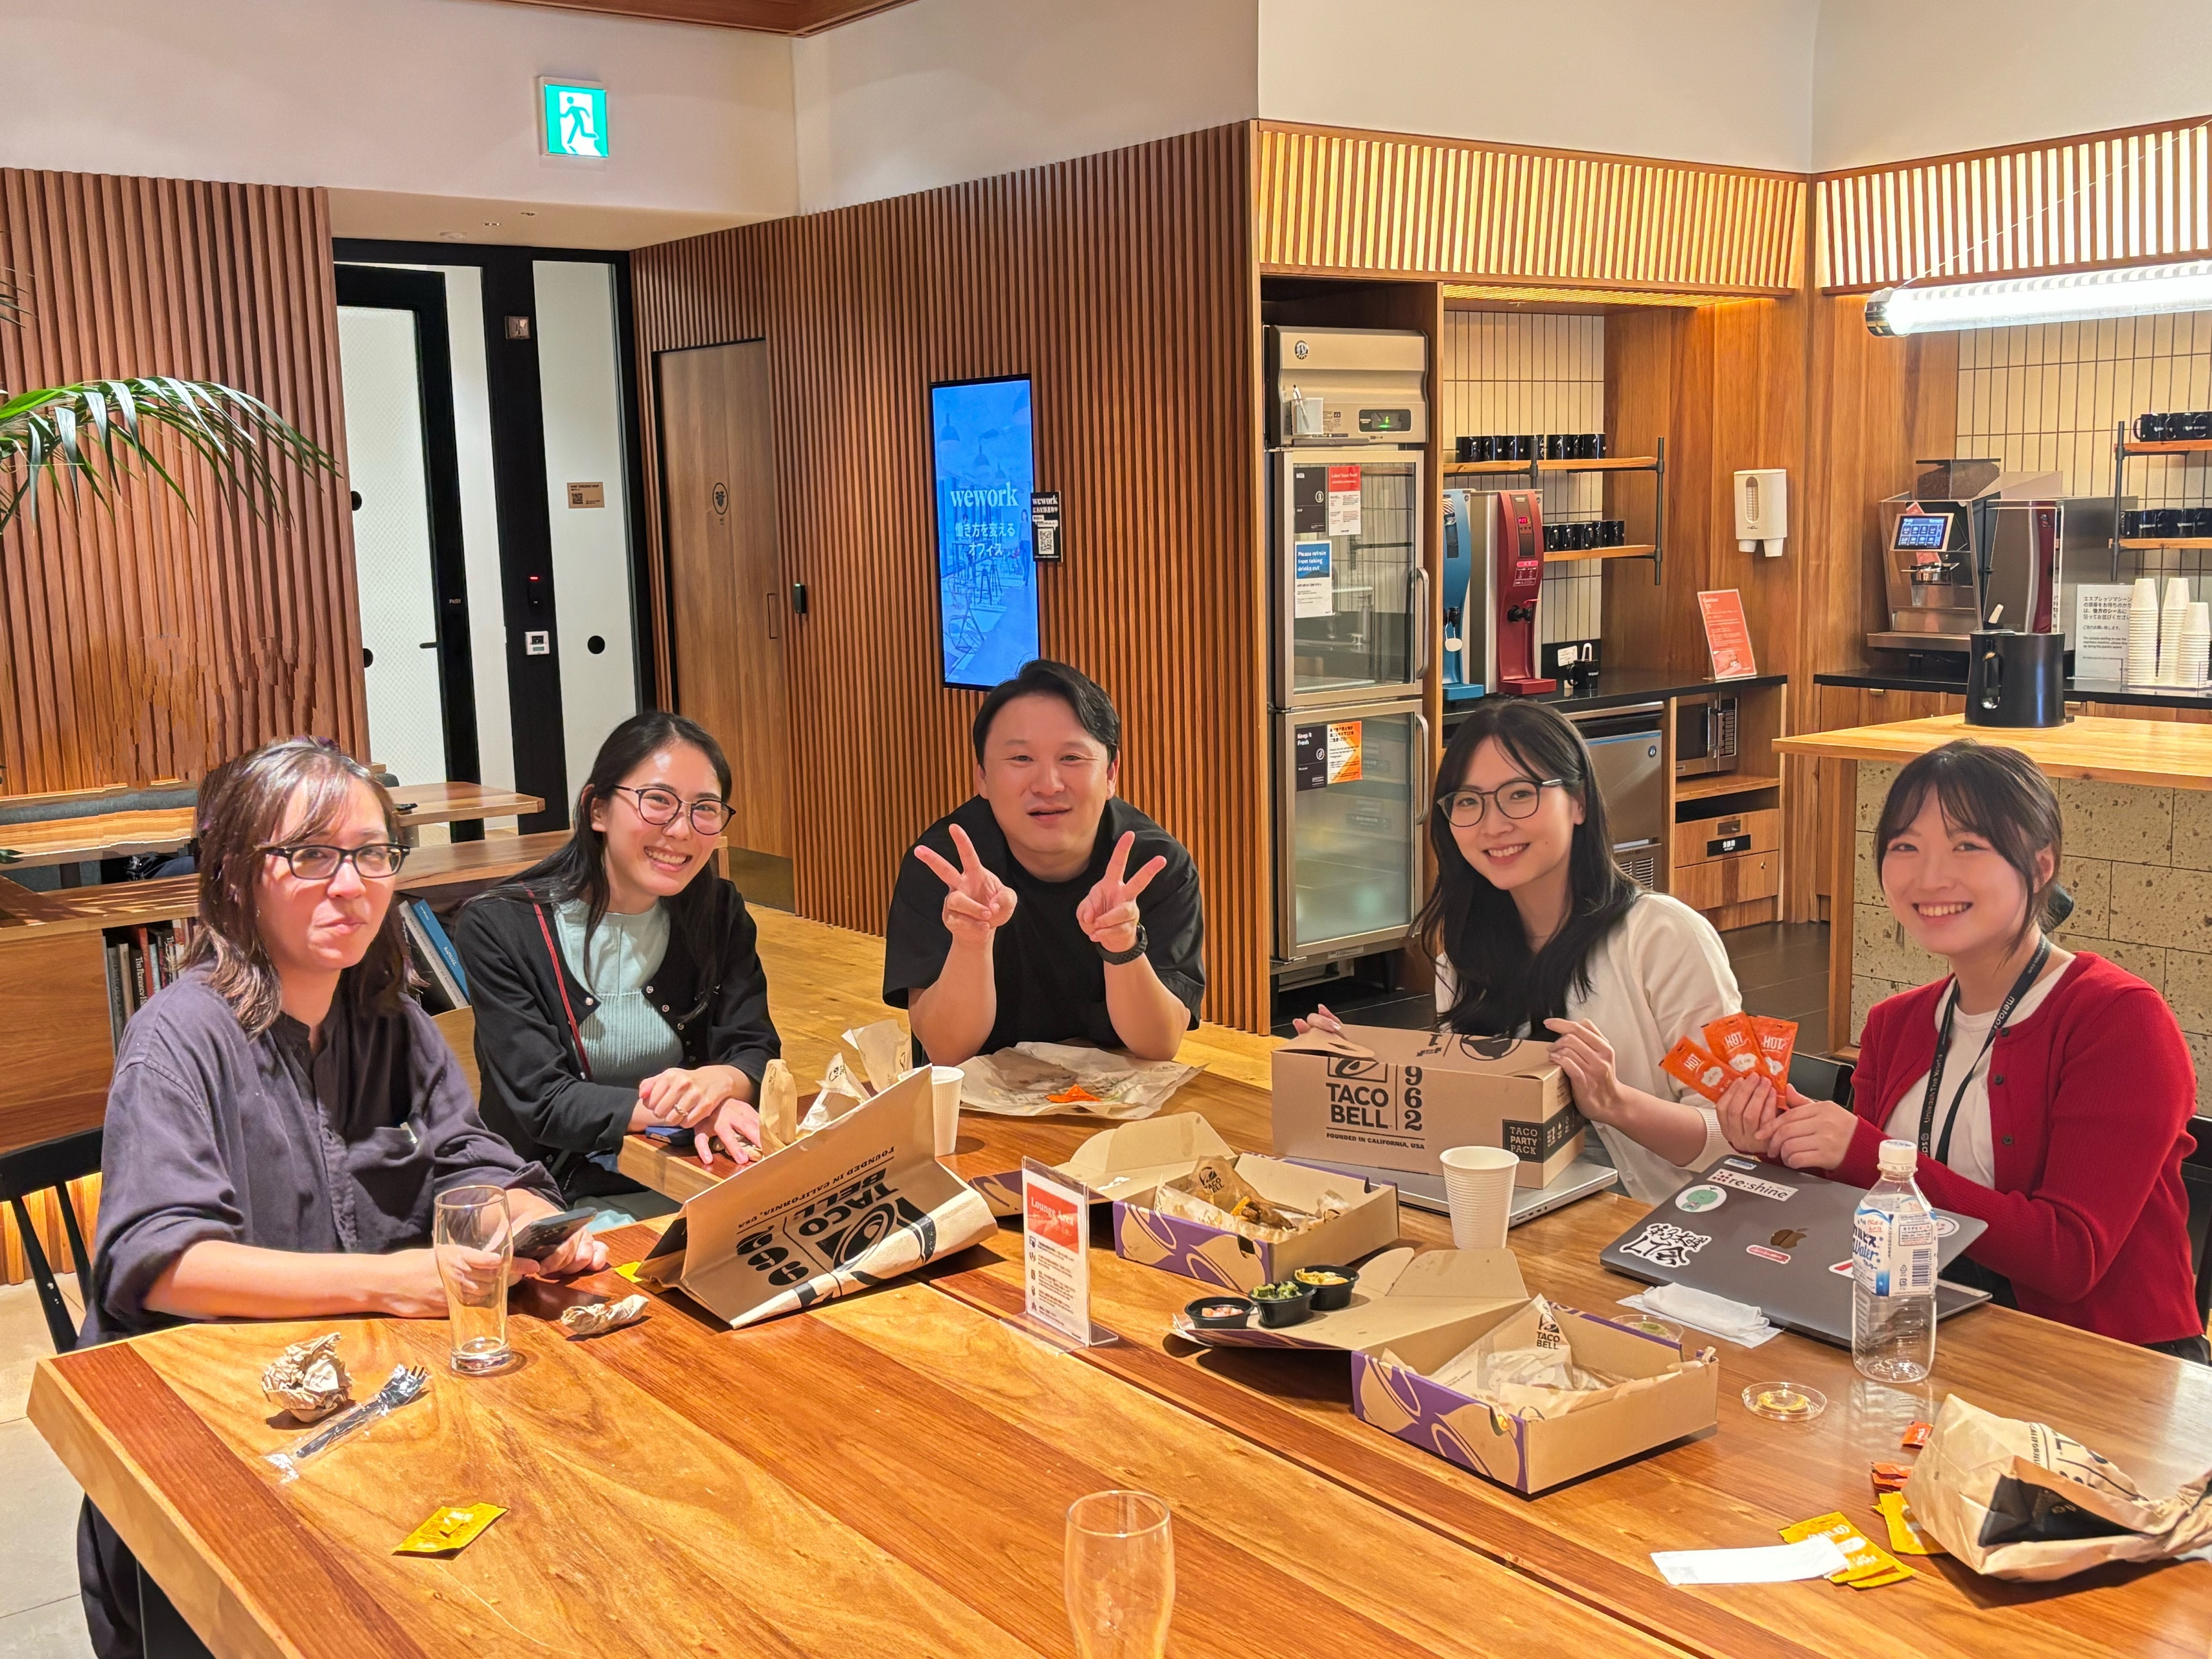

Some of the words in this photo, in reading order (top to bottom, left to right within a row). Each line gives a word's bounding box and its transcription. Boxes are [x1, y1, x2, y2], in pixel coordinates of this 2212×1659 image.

[950, 481, 1019, 507] wework
[1032, 495, 1058, 505] wework
[955, 522, 1015, 537] 働き方を変える
[969, 542, 1003, 557] オフィス
[1725, 1031, 1744, 1047] HOT
[1763, 1035, 1784, 1050] HOT
[1684, 1052, 1701, 1071] HOT
[1326, 1083, 1389, 1108] TACO
[1331, 1104, 1388, 1129] BELL
[1509, 1126, 1538, 1137] TACO
[1327, 1133, 1356, 1142] FOUNDED
[1368, 1137, 1409, 1148] CALIFORNIA,
[1510, 1135, 1537, 1146] PARTY
[1511, 1144, 1537, 1155] PACK
[846, 1146, 895, 1176] FOUNDED
[833, 1173, 844, 1184] IN
[793, 1168, 887, 1218] BELL
[1212, 1183, 1224, 1193] ELL
[1728, 1176, 1788, 1198] re:shine
[760, 1181, 830, 1216] CALIFORNIA,
[798, 1182, 900, 1236] TACO
[1030, 1196, 1056, 1218] Lounge
[1057, 1210, 1074, 1226] Area
[738, 1216, 758, 1229] USA
[1536, 1332, 1560, 1343] TACO
[1536, 1340, 1559, 1350] BELL
